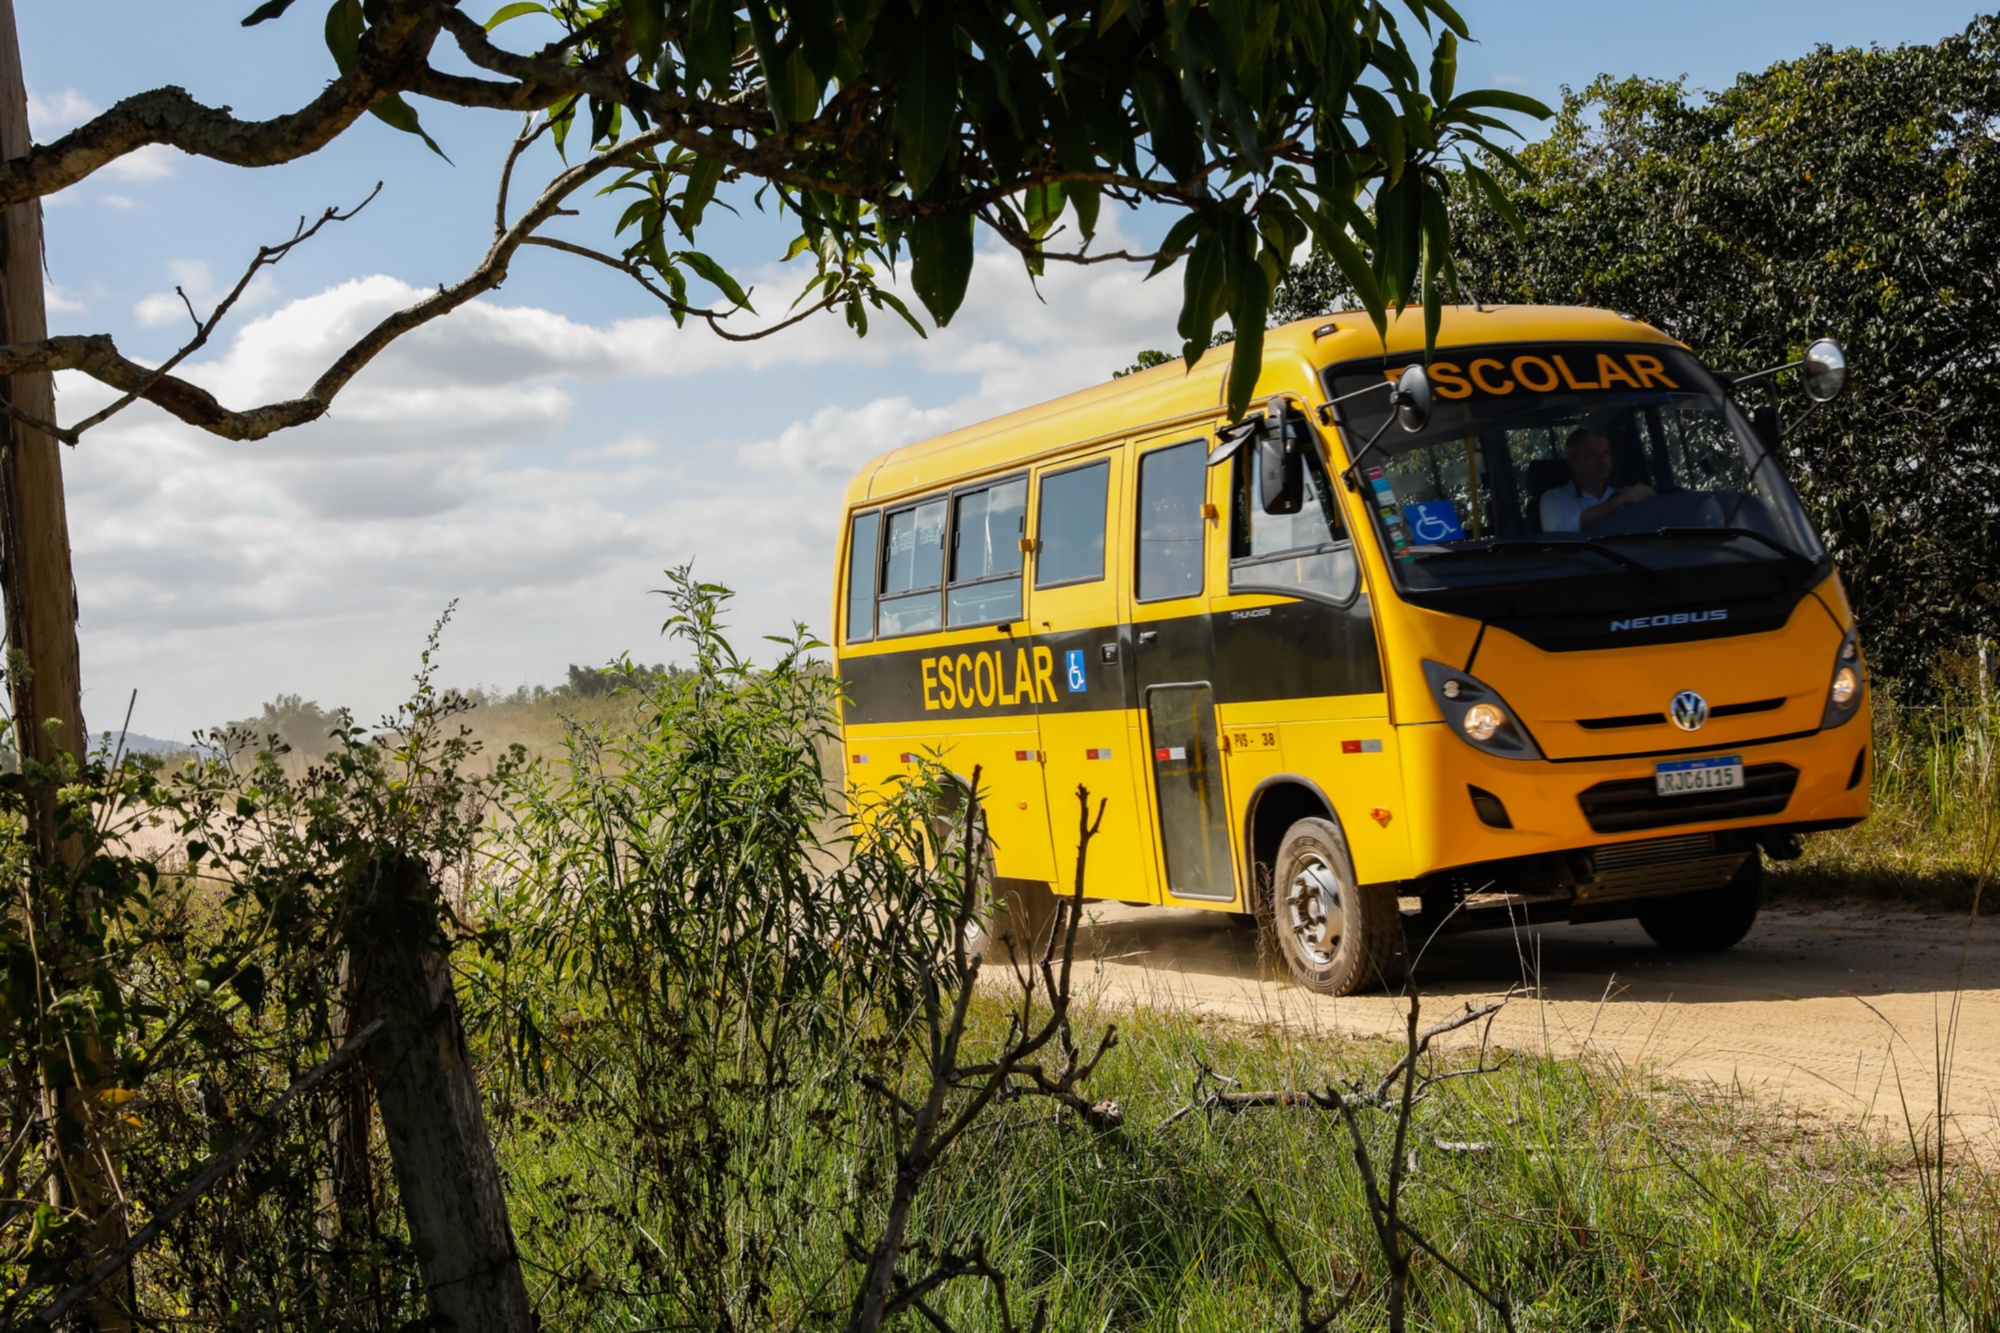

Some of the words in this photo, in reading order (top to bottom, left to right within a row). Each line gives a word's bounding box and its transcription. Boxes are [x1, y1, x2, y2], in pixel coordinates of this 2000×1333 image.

[1610, 609, 1728, 632] NEOBUS
[921, 646, 1058, 710] ESCOLAR
[1261, 732, 1275, 746] 38
[1664, 767, 1734, 791] RJC6I15
